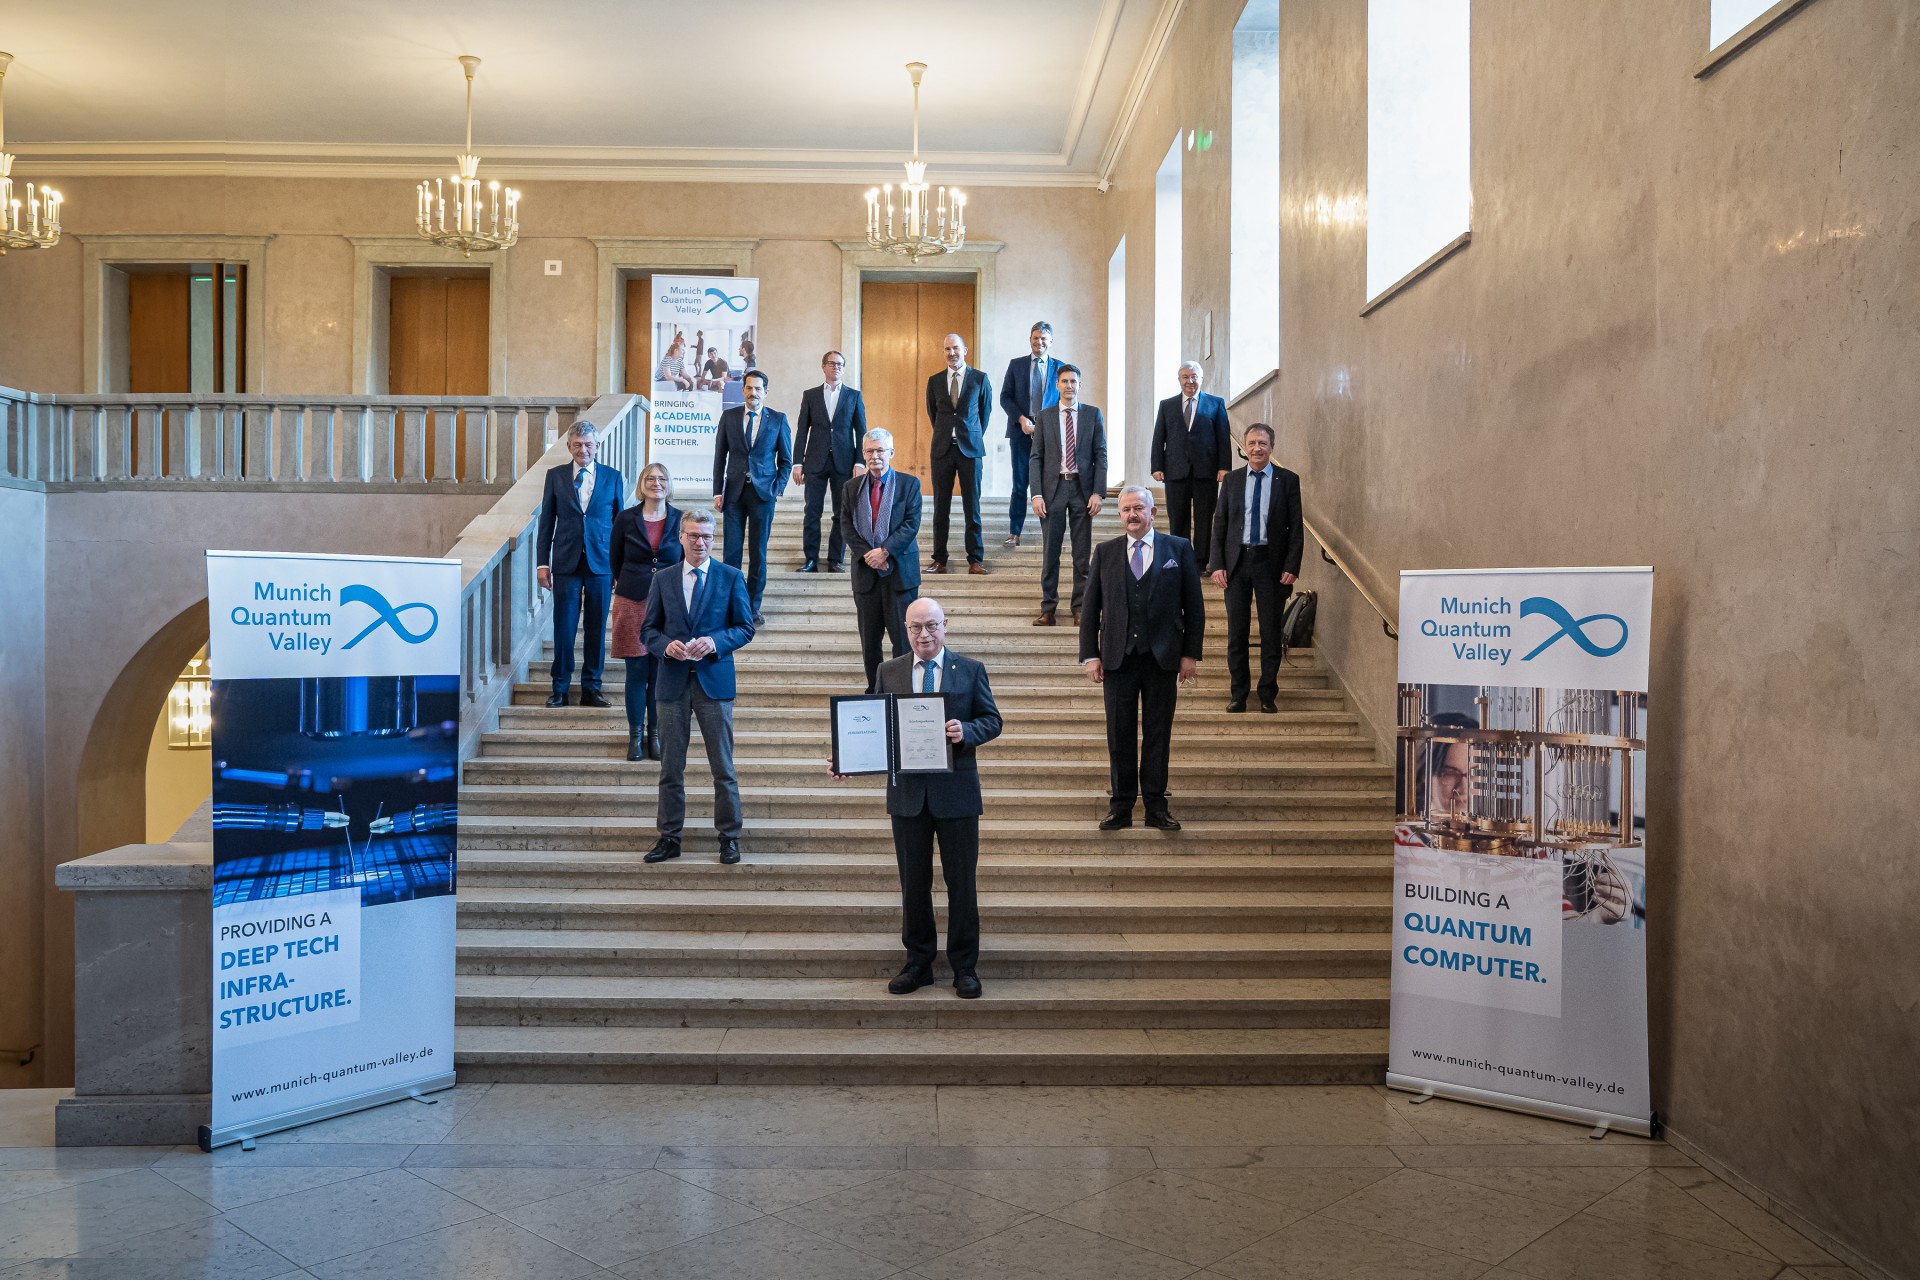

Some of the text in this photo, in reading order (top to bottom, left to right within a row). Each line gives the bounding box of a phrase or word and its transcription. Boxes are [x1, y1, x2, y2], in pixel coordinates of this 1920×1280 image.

[660, 295, 702, 304] Quantum
[670, 286, 702, 294] Munich
[675, 305, 702, 315] Valley
[654, 411, 712, 421] ACADEMIA
[654, 424, 718, 434] & INDUSTRY
[654, 438, 699, 447] TOGETHER.
[254, 582, 331, 601] Munich
[231, 606, 331, 626] Quantum
[1441, 597, 1512, 614] Munich
[1420, 619, 1511, 637] Quantum
[268, 632, 332, 656] Valley
[1453, 643, 1512, 666] Valley
[1405, 883, 1510, 910] BUILDING A
[221, 912, 332, 941] PROVIDING A
[1403, 912, 1532, 947] QUANTUM
[220, 934, 339, 971] DEEP TECH
[1403, 945, 1547, 984] COMPUTER.
[220, 971, 295, 1000] INFRA-
[219, 988, 352, 1030] STRUCTURE.
[231, 1046, 434, 1102] www.munich-quantum-valley.de
[1411, 1049, 1625, 1095] www.munich-quantum-valley.de
